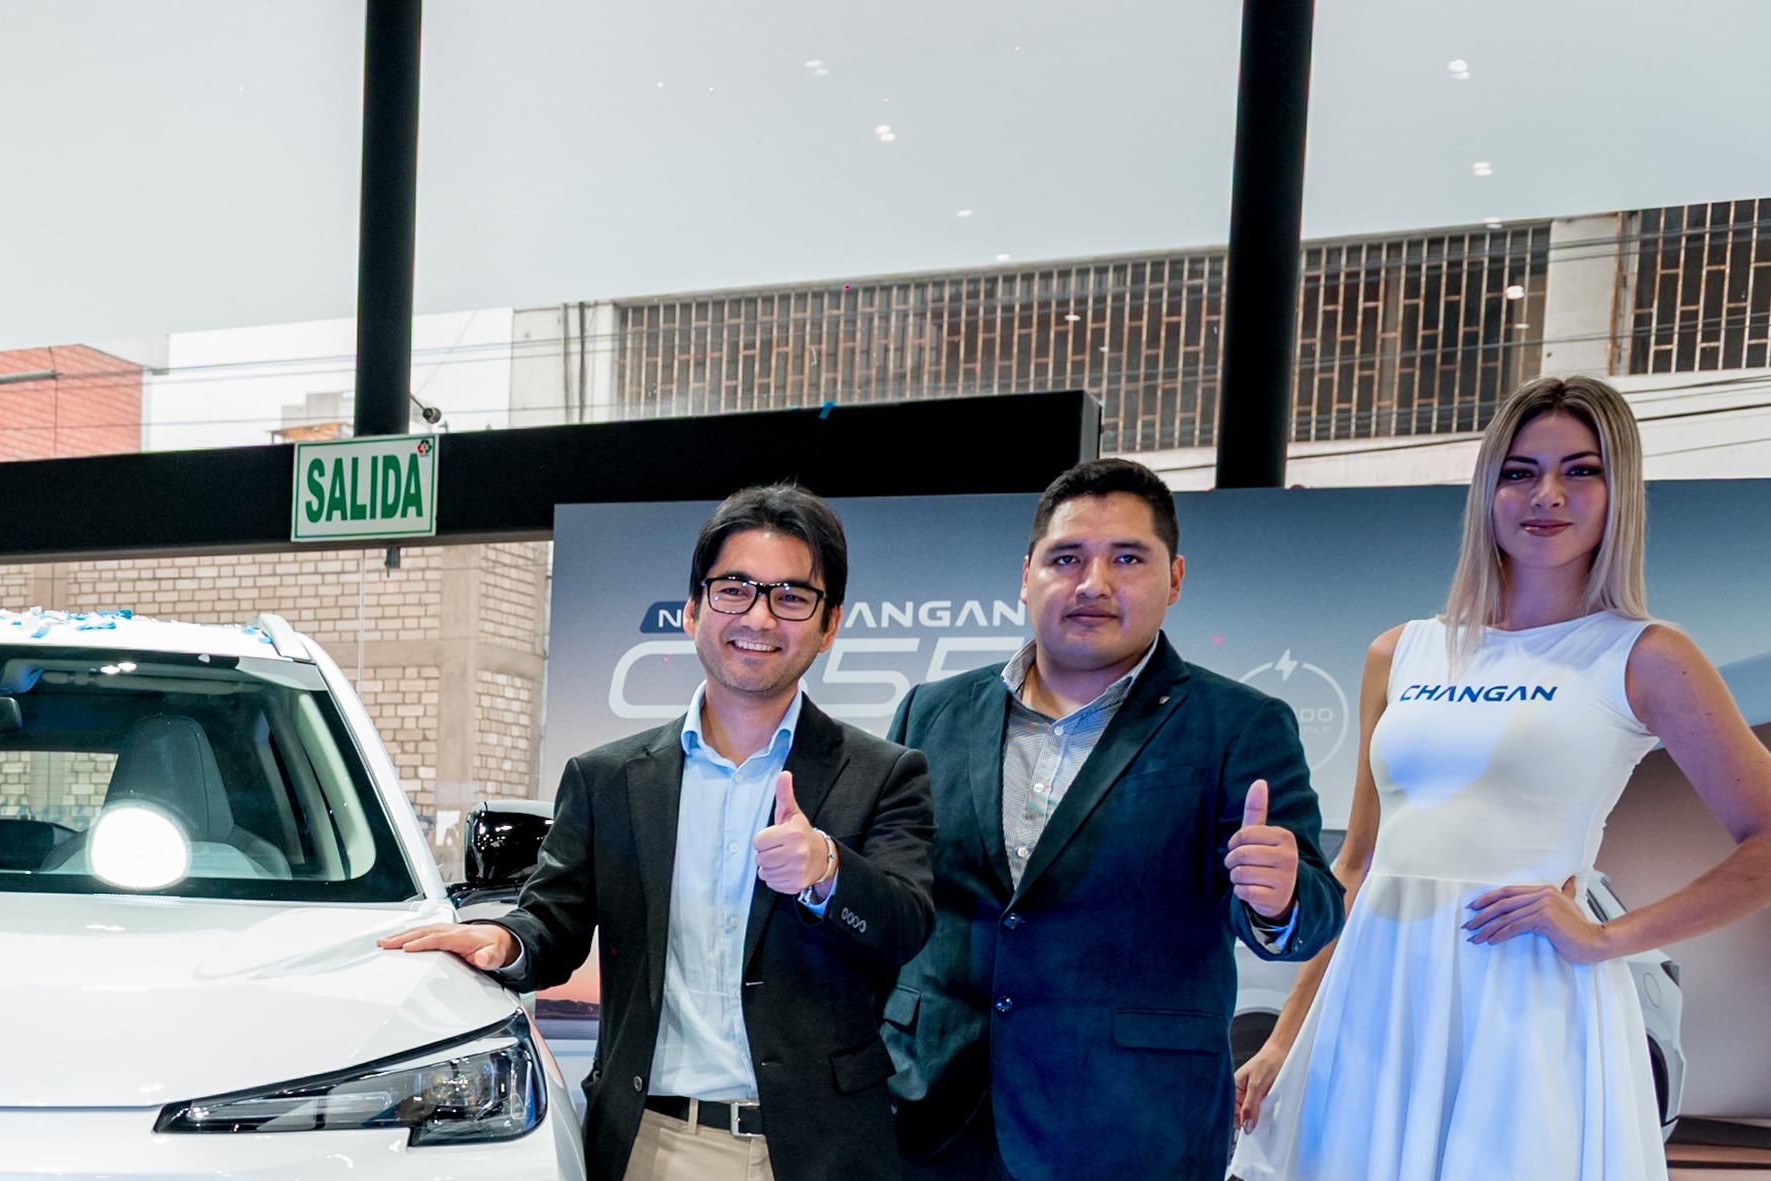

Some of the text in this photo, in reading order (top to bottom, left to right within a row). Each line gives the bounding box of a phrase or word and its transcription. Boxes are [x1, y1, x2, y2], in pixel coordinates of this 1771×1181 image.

[305, 453, 424, 524] SALIDA
[844, 600, 1026, 629] ANGAN
[1399, 684, 1558, 703] CHANGAN
